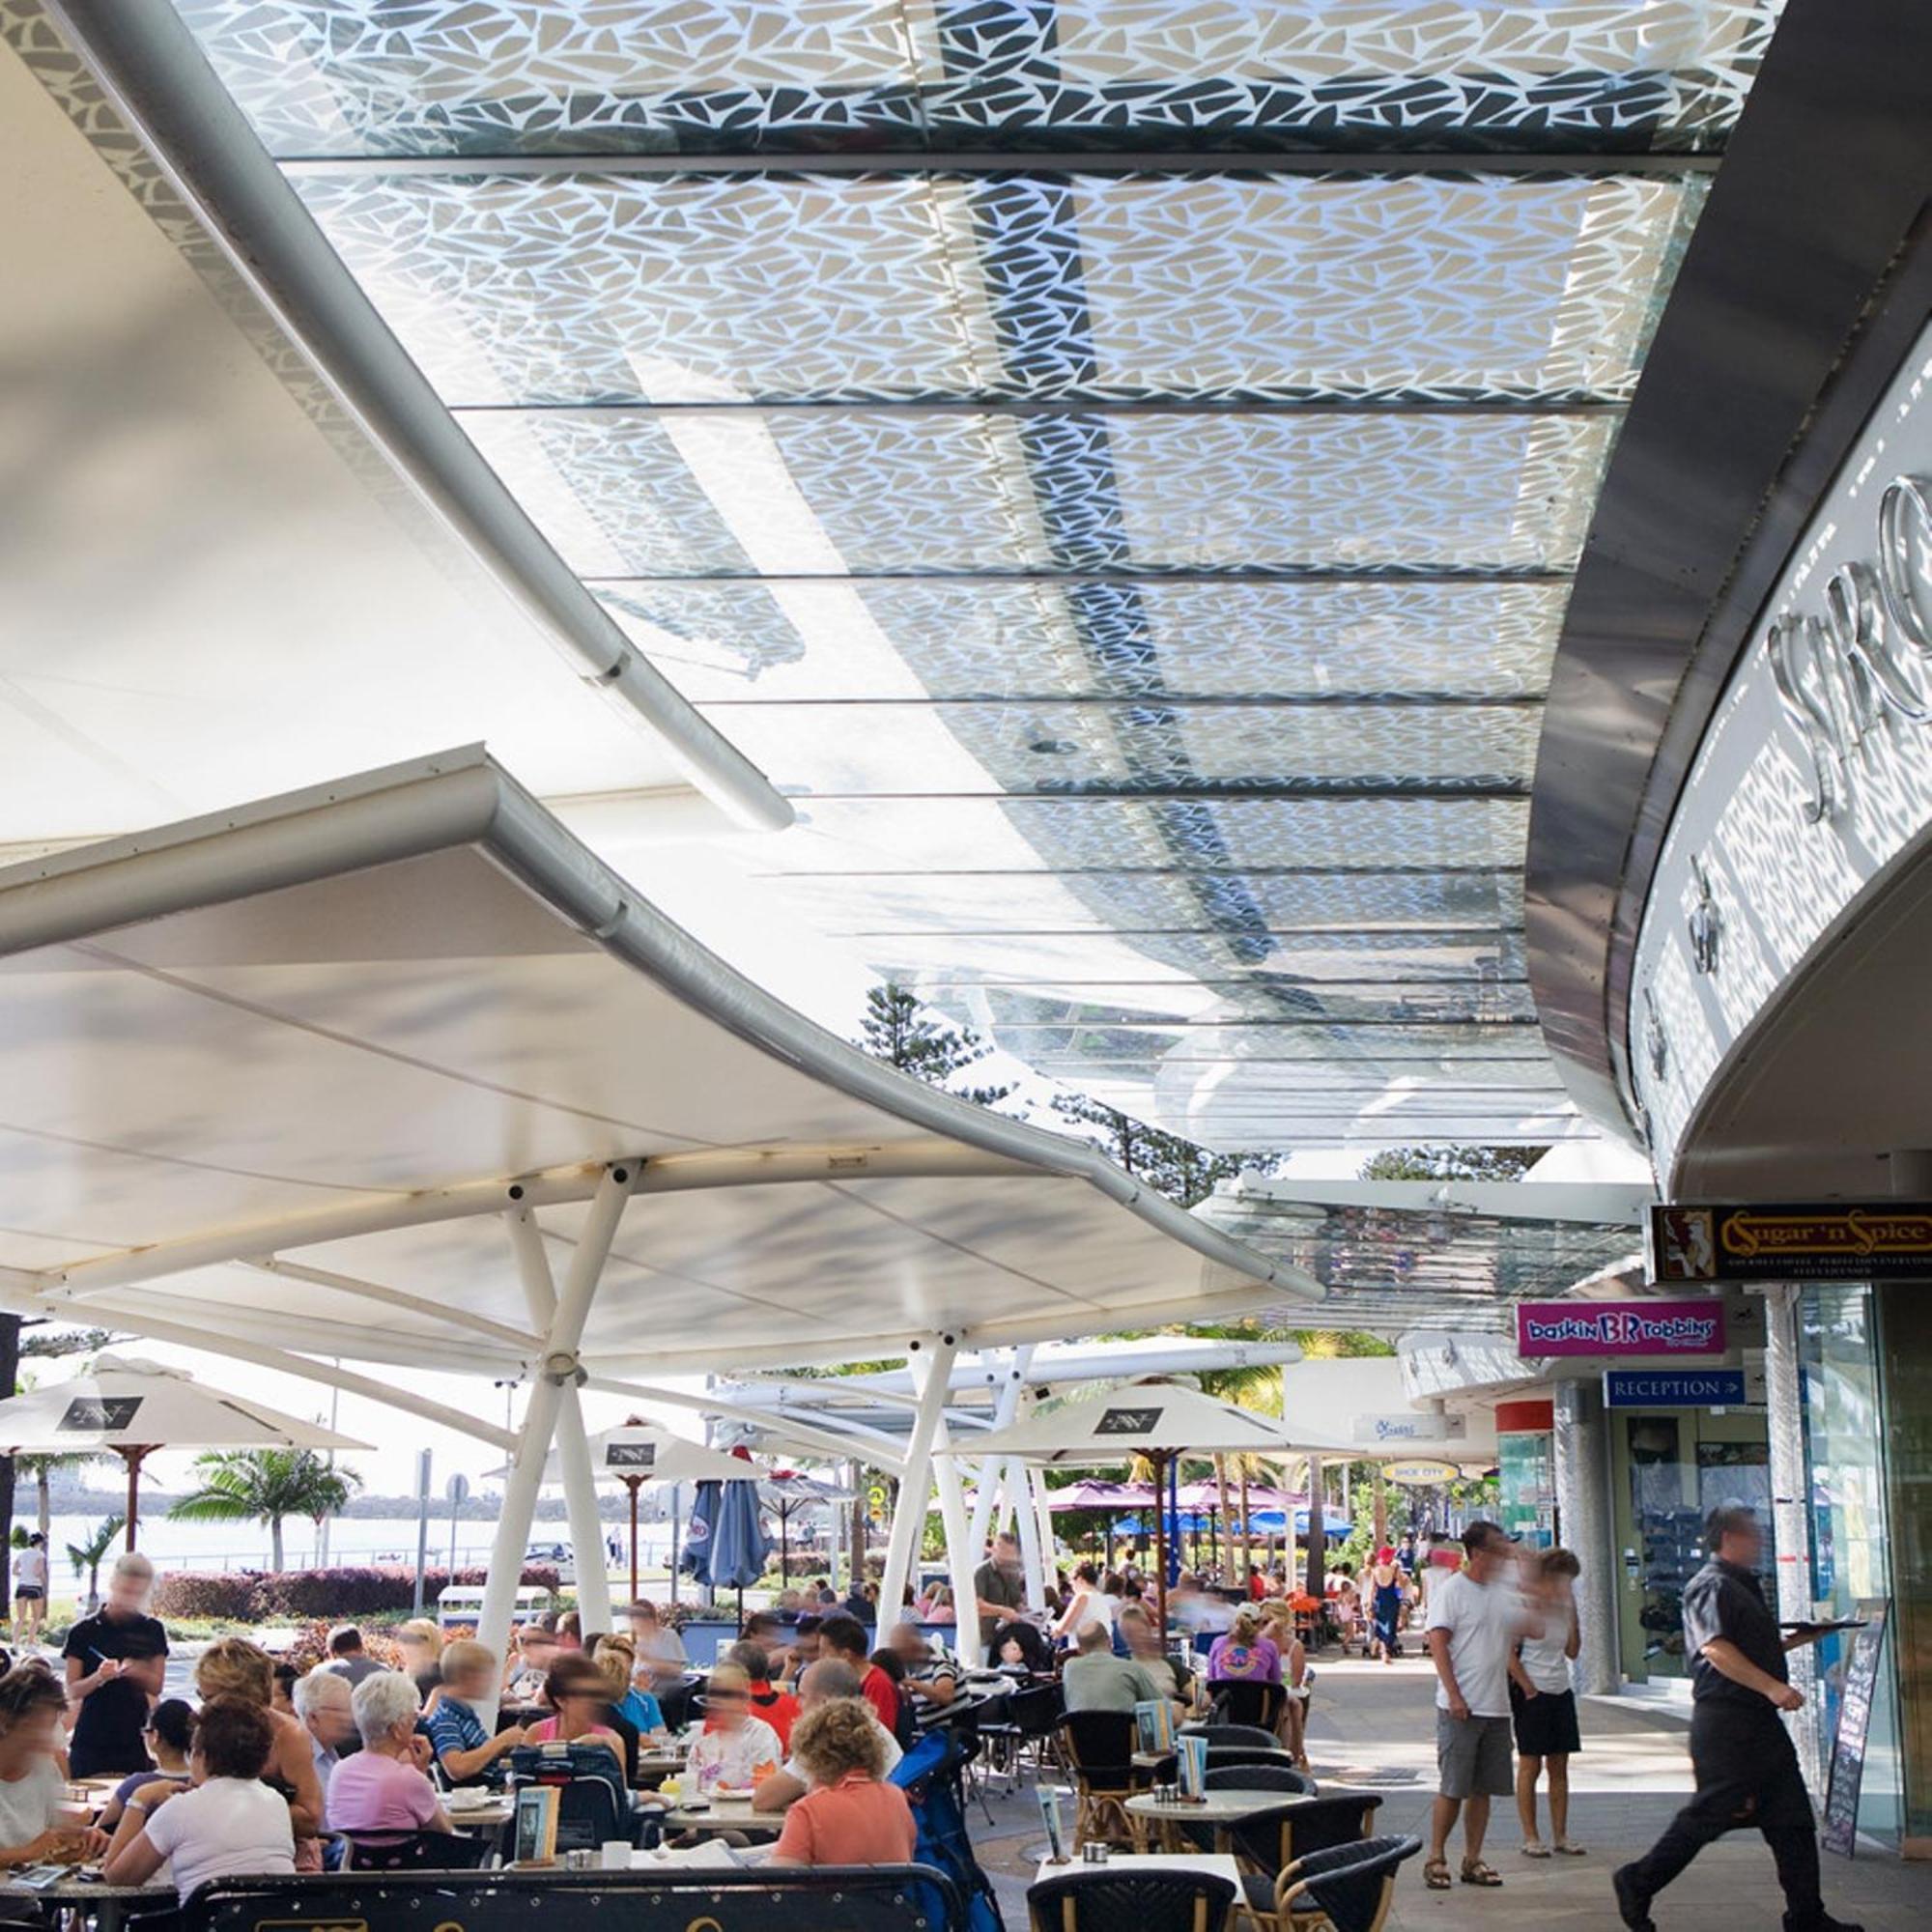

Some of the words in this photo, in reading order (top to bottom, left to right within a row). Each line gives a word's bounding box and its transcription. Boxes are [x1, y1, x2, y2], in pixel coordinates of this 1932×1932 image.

[1732, 1210, 1814, 1256] Sugar
[1847, 1209, 1926, 1256] Spice
[1528, 1320, 1599, 1341] baskin
[1598, 1313, 1641, 1344] BR
[1643, 1320, 1715, 1340] robbins
[1614, 1380, 1719, 1397] RECEPTION
